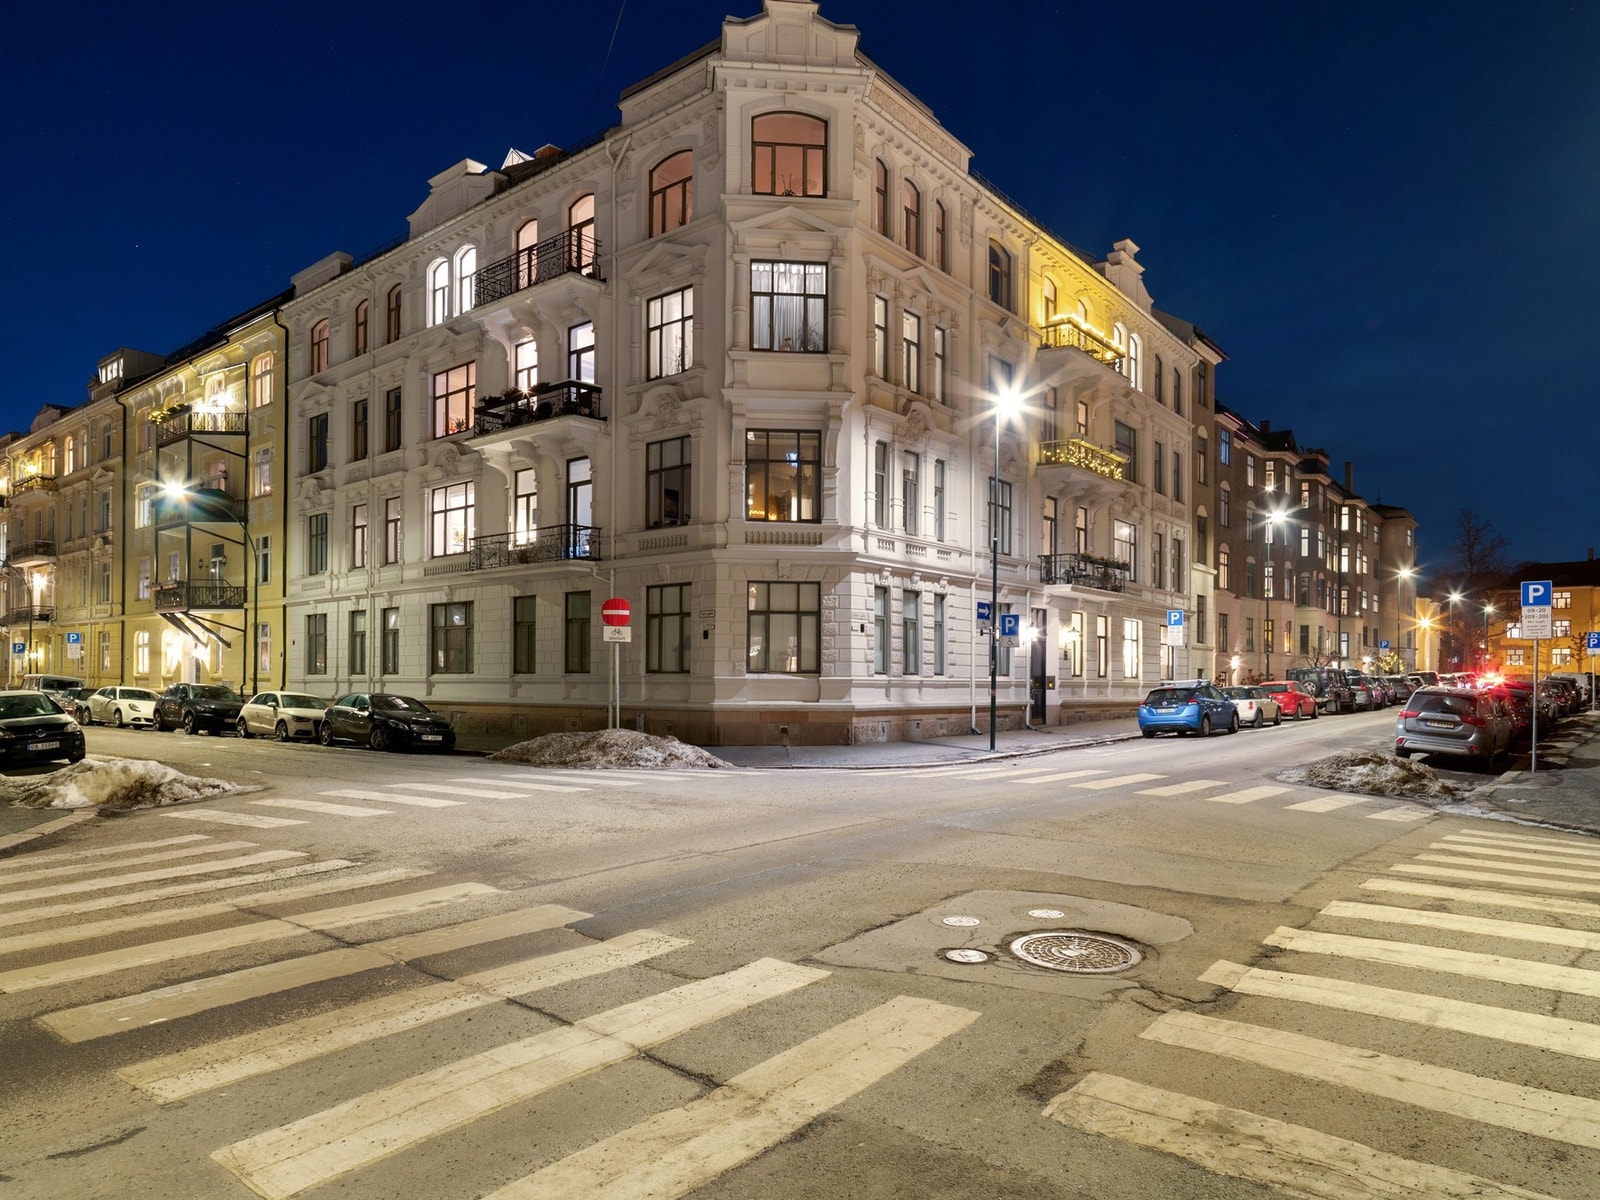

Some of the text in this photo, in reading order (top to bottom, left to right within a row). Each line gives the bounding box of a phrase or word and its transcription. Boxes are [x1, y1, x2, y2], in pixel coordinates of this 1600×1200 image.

[1528, 584, 1545, 604] P
[1171, 612, 1180, 625] P
[1005, 617, 1015, 634] P
[69, 633, 77, 643] P
[1590, 638, 1598, 648] P
[15, 644, 23, 653] P
[1381, 640, 1388, 648] P
